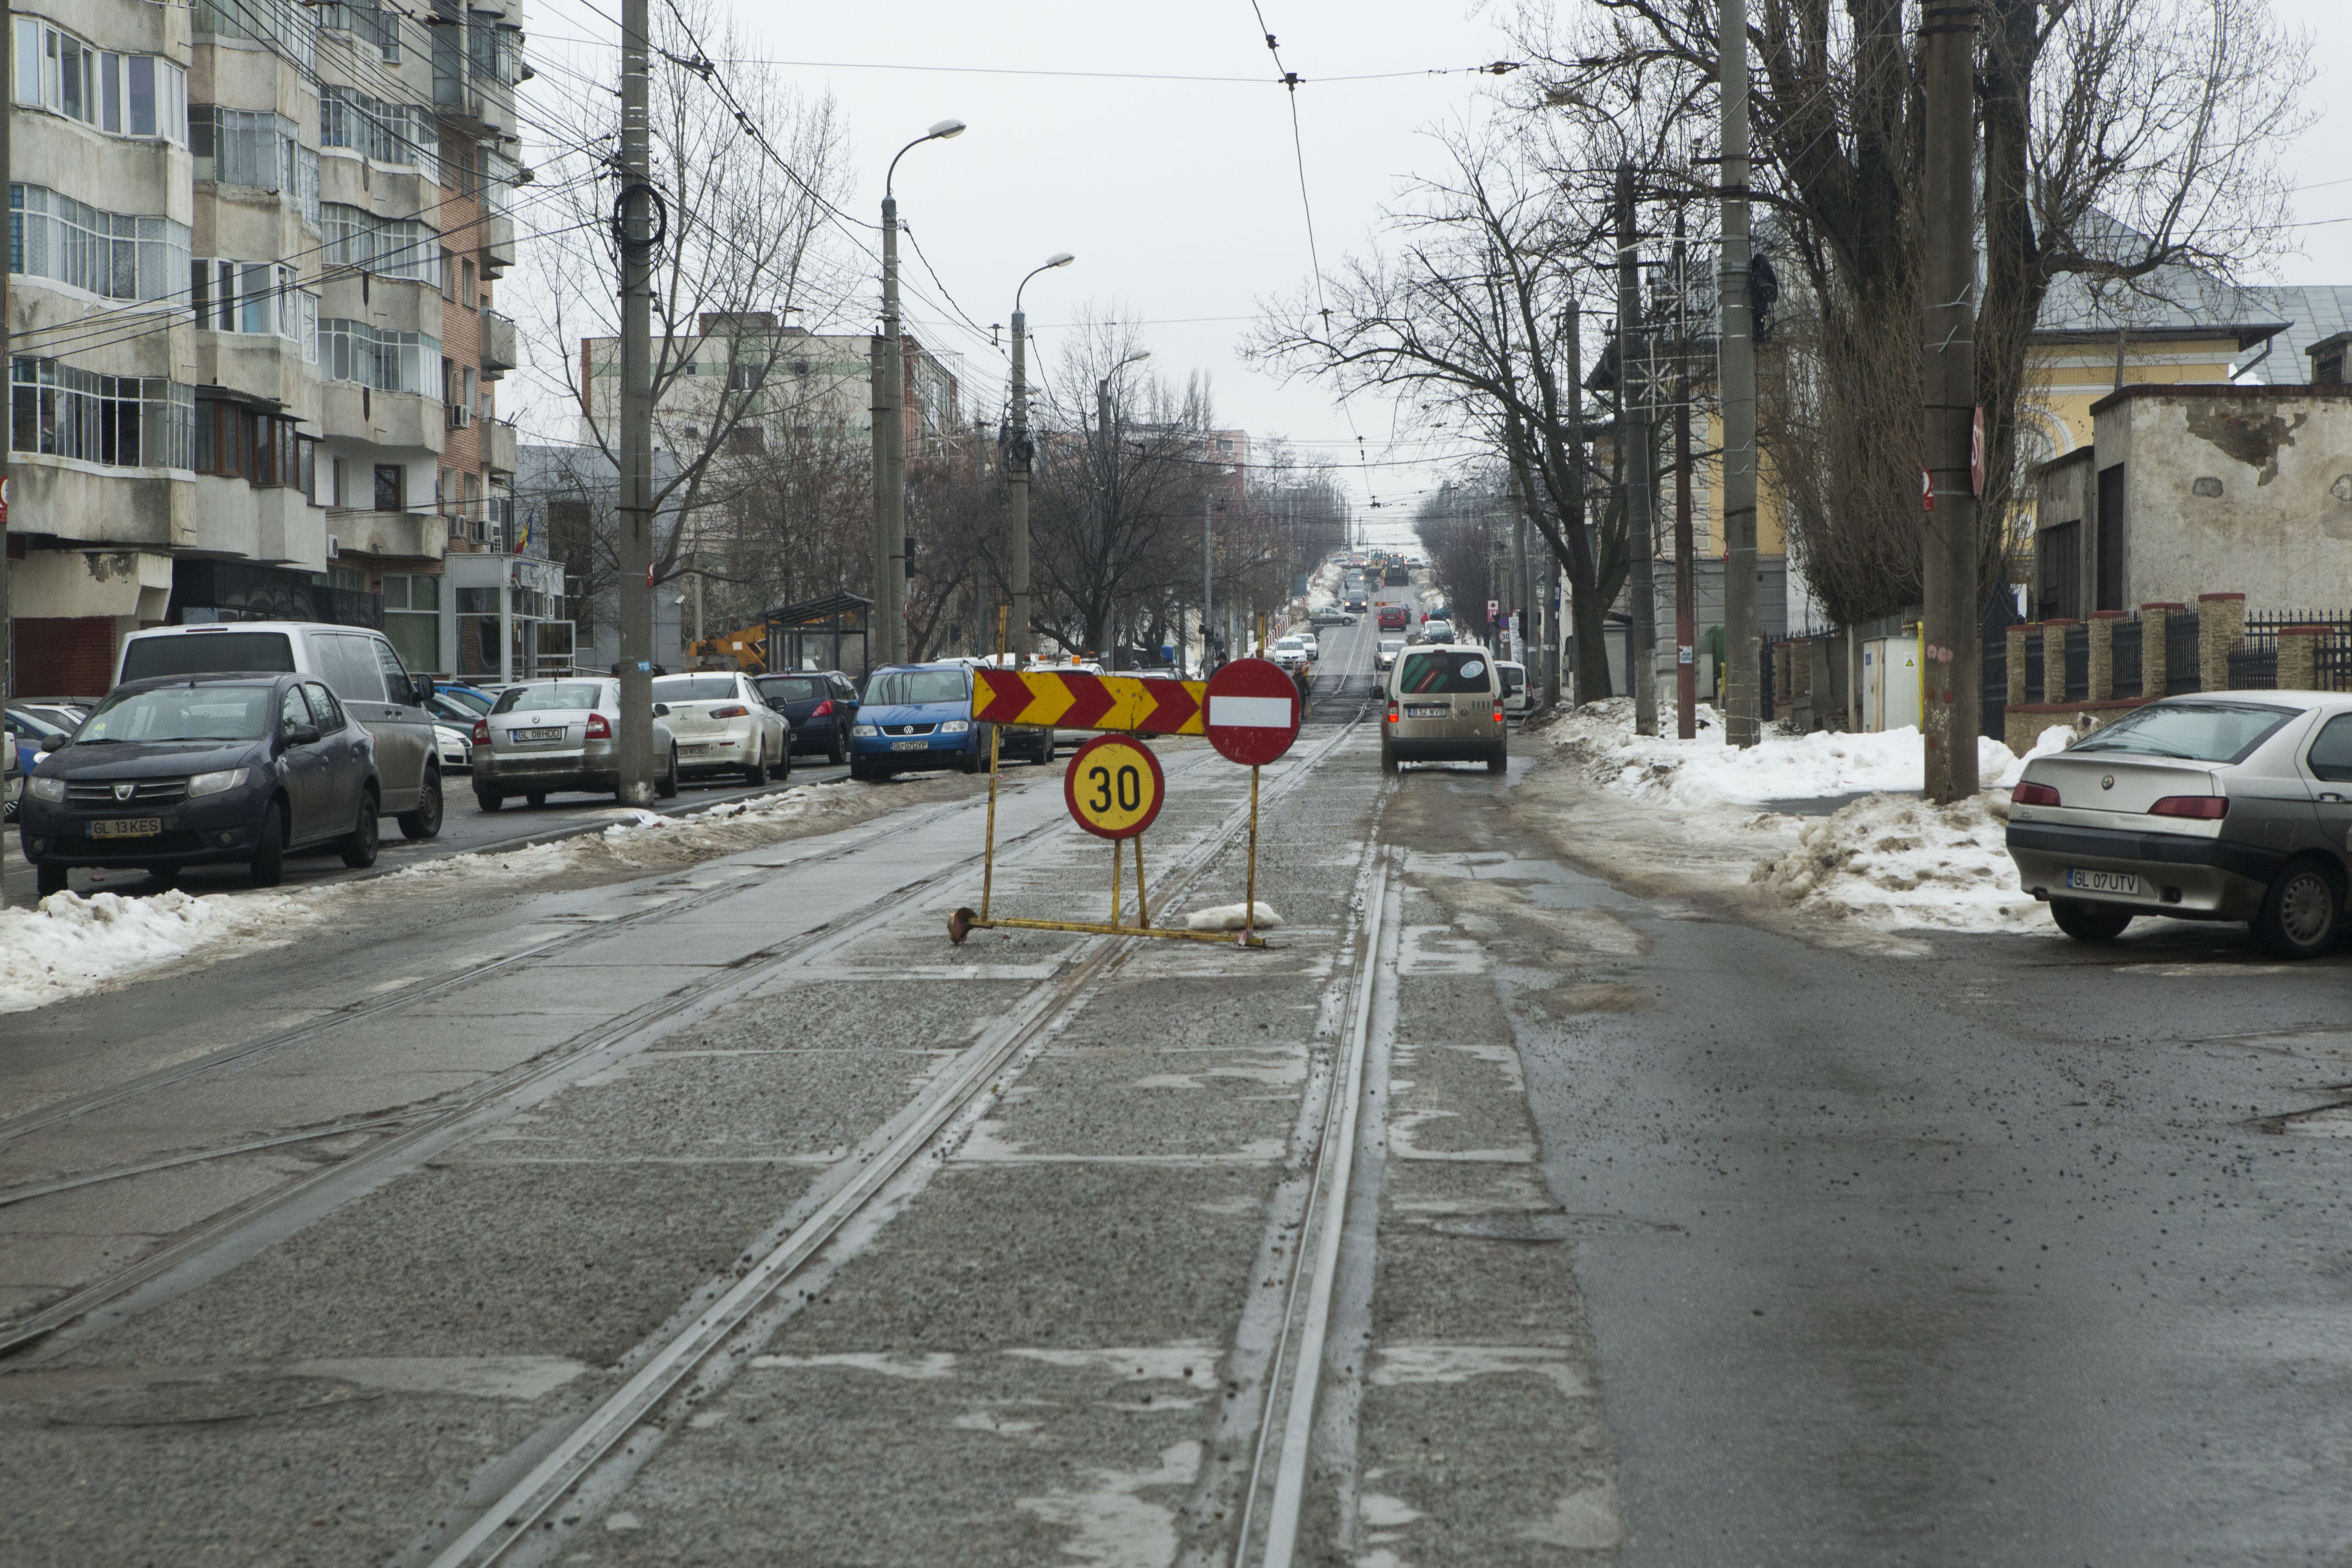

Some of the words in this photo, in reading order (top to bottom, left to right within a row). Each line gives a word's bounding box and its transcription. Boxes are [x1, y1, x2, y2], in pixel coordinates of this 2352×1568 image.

[1089, 765, 1140, 813] 30
[94, 822, 110, 834] GL
[2075, 871, 2089, 887] GL
